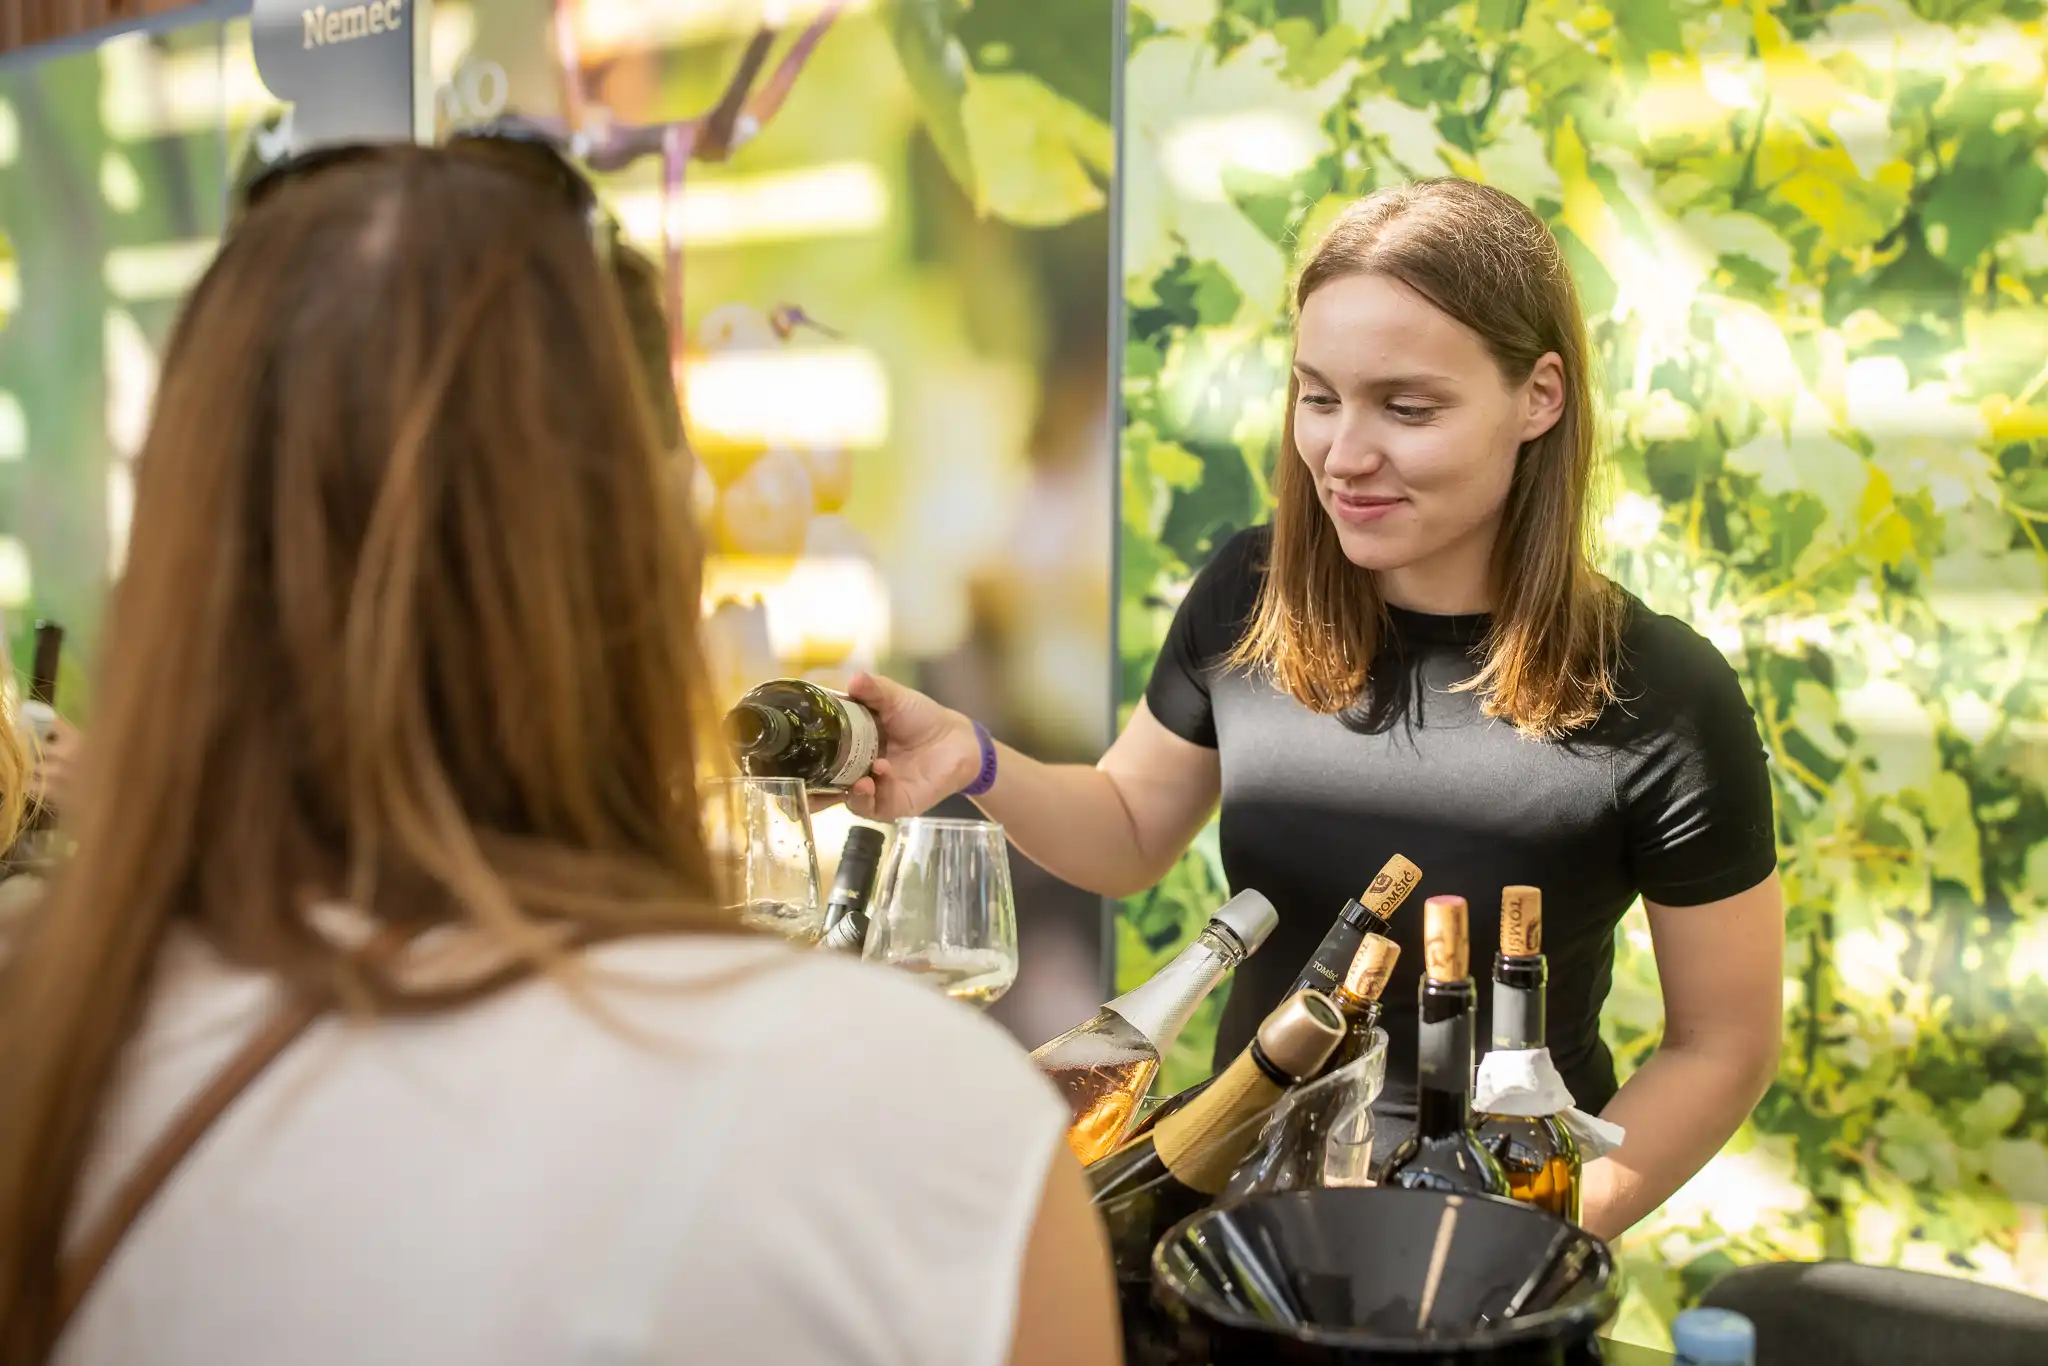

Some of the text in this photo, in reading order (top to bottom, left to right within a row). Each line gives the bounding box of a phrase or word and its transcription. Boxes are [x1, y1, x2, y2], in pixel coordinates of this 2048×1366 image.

[302, 0, 402, 49] Nemec
[1376, 870, 1415, 917] TOMŠIĆ
[1312, 960, 1339, 982] TOMŠIĆ
